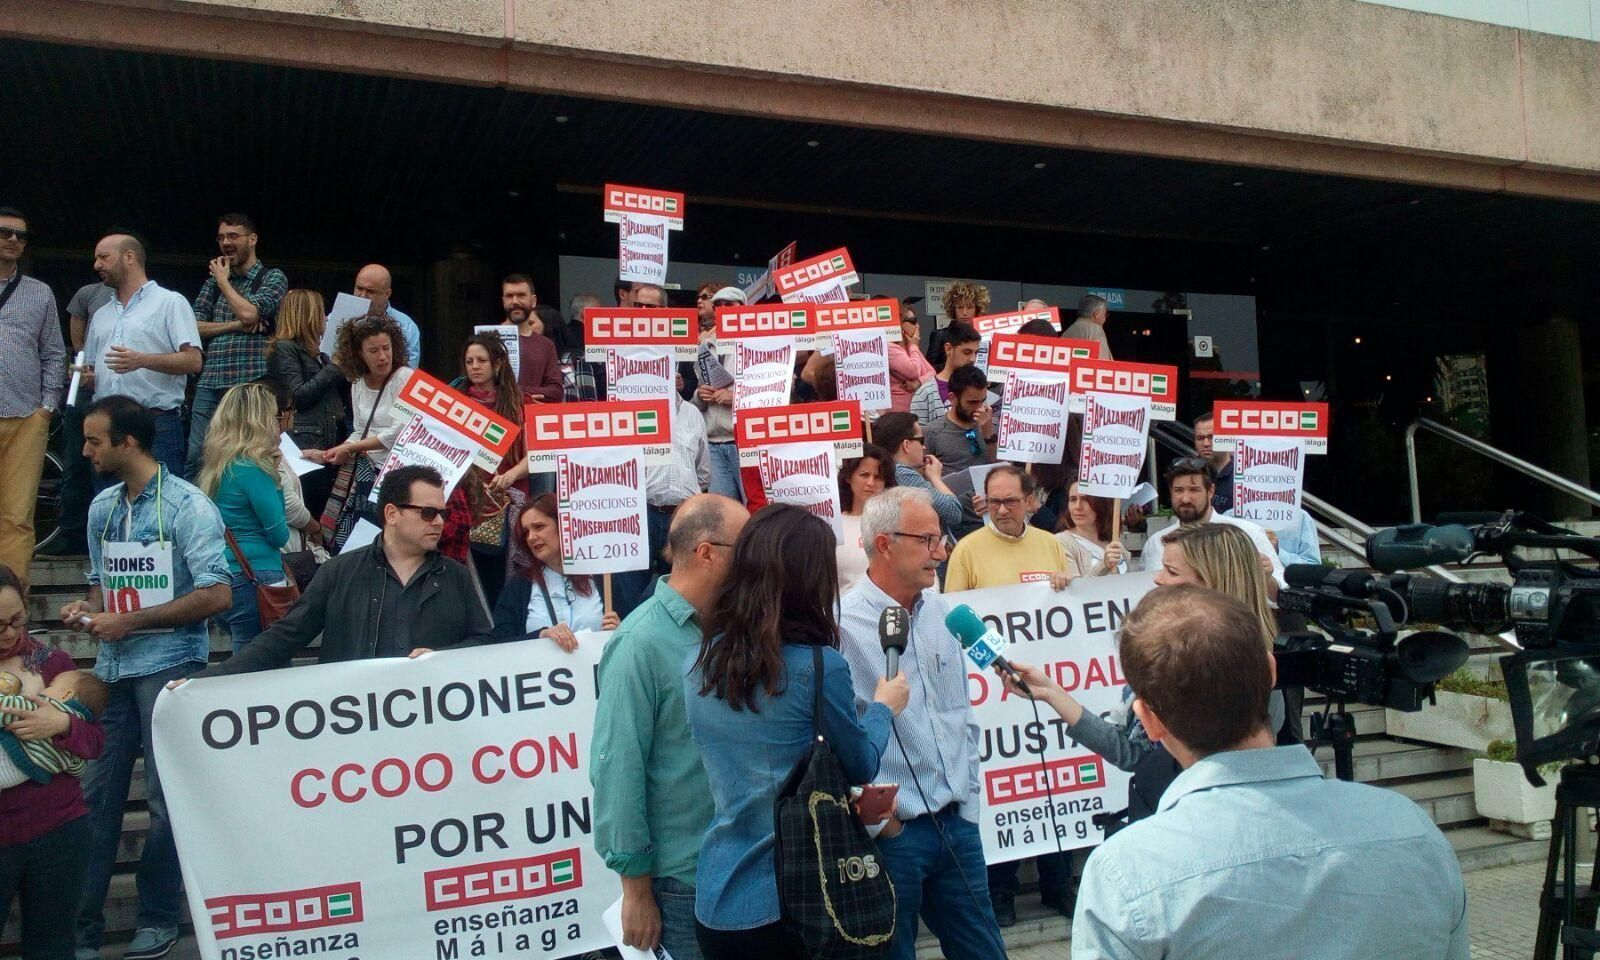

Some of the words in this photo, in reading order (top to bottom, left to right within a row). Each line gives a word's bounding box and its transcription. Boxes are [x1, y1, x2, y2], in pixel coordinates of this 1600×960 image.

[610, 191, 664, 211] CCOO
[628, 266, 640, 274] AL
[643, 266, 662, 277] 2018
[779, 259, 834, 289] CCOO
[592, 317, 670, 338] CCOO
[722, 311, 790, 332] CCOO
[816, 306, 877, 326] CCOO
[979, 313, 1037, 331] CCOO
[744, 345, 791, 369] APLAZAMIENTO
[841, 336, 883, 359] APLAZAMIENTO
[997, 341, 1071, 366] CCOO
[617, 355, 670, 381] APLAZAMIENTO
[1076, 367, 1149, 393] CCOO
[616, 385, 668, 394] OPOSICIONES
[864, 390, 885, 401] 2018
[1013, 378, 1066, 405] APLAZAMIENTO
[409, 379, 489, 436] CCOO
[1010, 405, 1061, 417] OPOSICIONES
[1094, 403, 1145, 433] APLAZAMIENTO
[1221, 409, 1298, 430] CCOO
[535, 411, 635, 440] CCOO
[744, 411, 831, 440] CCOO
[1009, 419, 1060, 439] CONSERVATORIOS
[409, 424, 471, 468] APLAZAMIENTO
[1007, 439, 1025, 451] AL
[1028, 441, 1056, 453] 2018
[1092, 435, 1140, 447] OPOSICIONES
[402, 448, 455, 476] OPOSICIONES
[770, 452, 830, 483] APLAZAMIENTO
[1091, 449, 1141, 469] CONSERVATORIOS
[1244, 445, 1298, 471] APLAZAMIENTO
[570, 458, 638, 494] APLAZAMIENTO
[1090, 473, 1109, 485] AL
[1244, 474, 1295, 484] OPOSICIONES
[773, 484, 830, 497] OPOSICIONES
[1243, 486, 1296, 506] CONSERVATORIOS
[570, 497, 638, 511] OPOSICIONES
[1243, 509, 1262, 520] AL
[1266, 509, 1293, 521] 2018
[572, 513, 640, 540] CONSERVATORIOS
[574, 545, 599, 560] AL
[603, 542, 639, 559] 2018
[202, 667, 577, 750] OPOSICIONES
[290, 751, 453, 808] CCOO
[472, 732, 579, 784] CON
[991, 765, 1076, 799] CCOO
[995, 796, 1104, 826] enseñanza
[394, 811, 509, 864] POR
[434, 864, 547, 903] CCOO
[434, 898, 579, 936] enseñanza
[436, 922, 581, 960] Málaga
